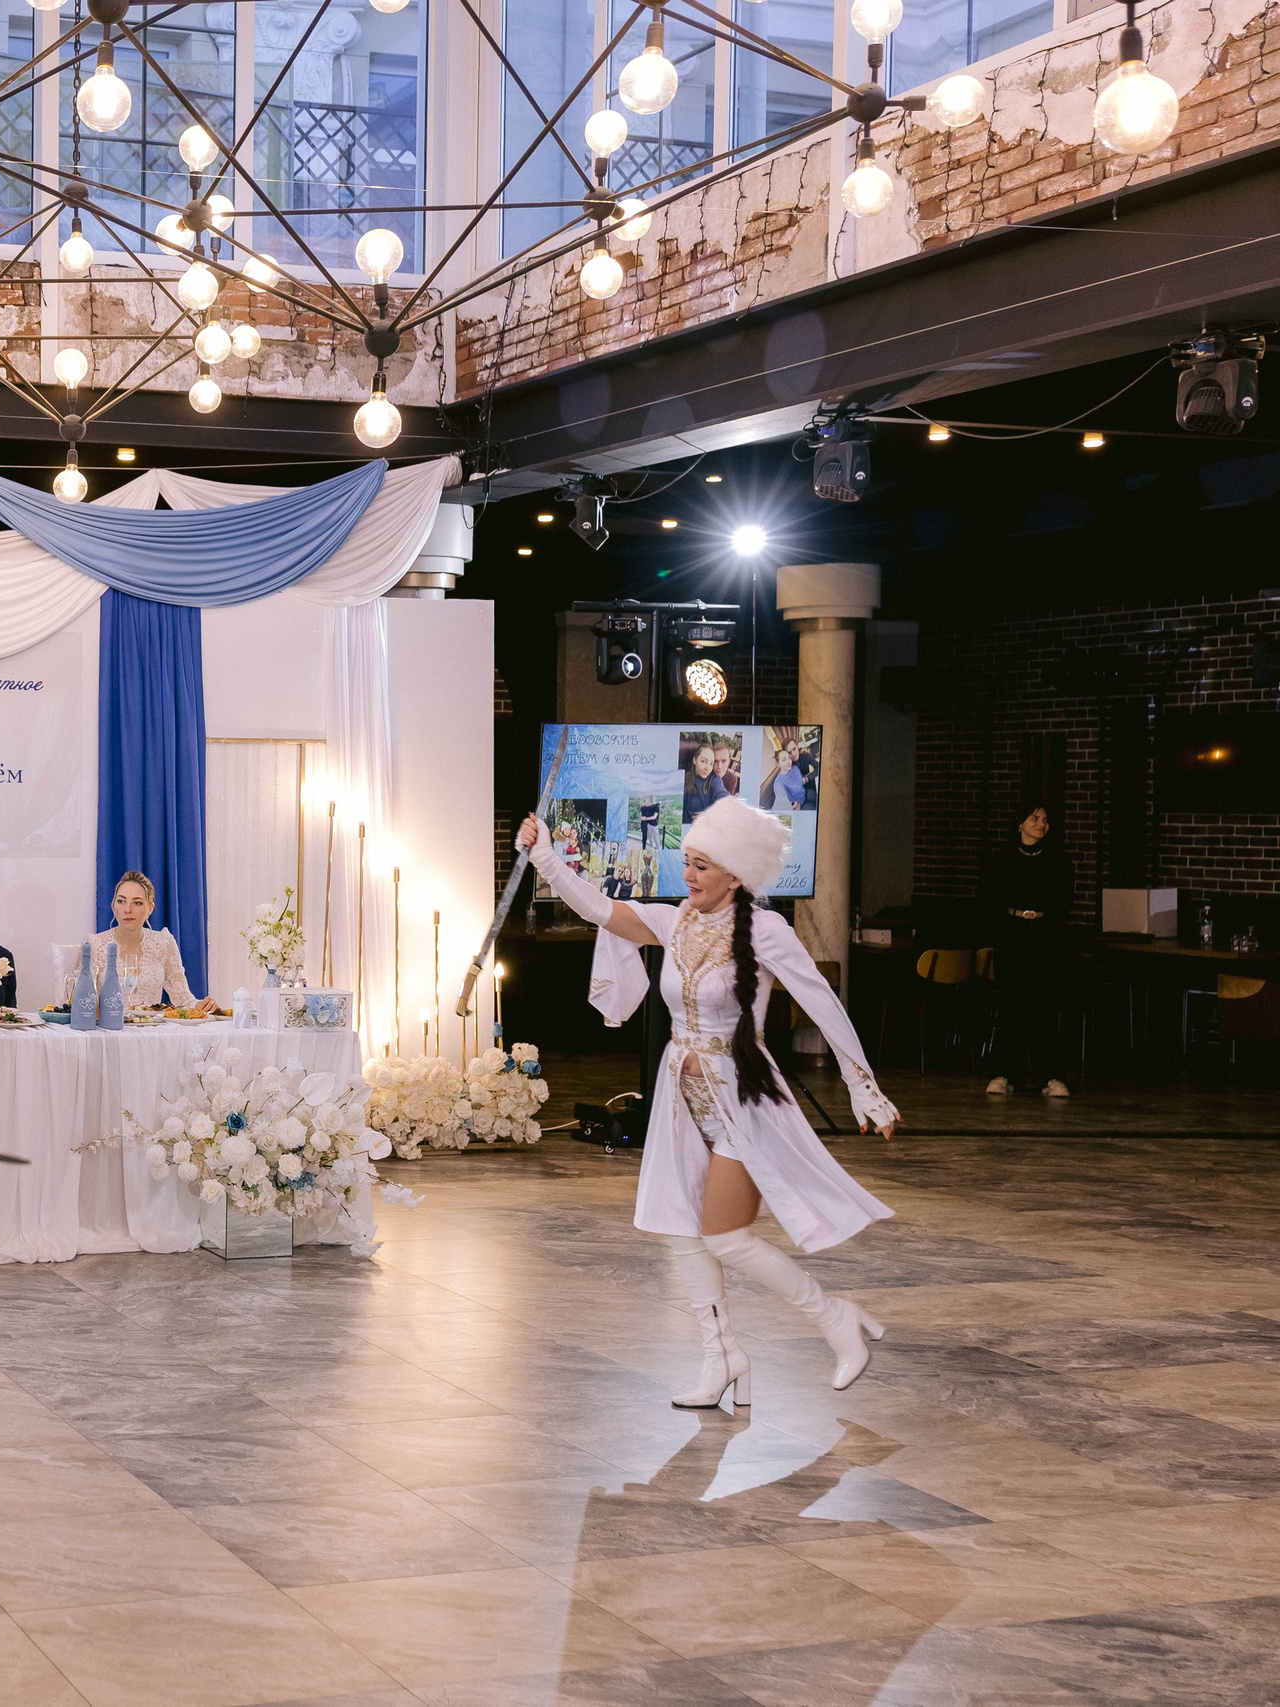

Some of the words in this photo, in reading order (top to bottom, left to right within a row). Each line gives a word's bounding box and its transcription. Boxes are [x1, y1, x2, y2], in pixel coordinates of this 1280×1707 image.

[568, 734, 639, 746] ЕДОВСКИЕ
[545, 752, 598, 764] АТЁМ
[784, 863, 802, 875] ay
[775, 876, 807, 889] 2026
